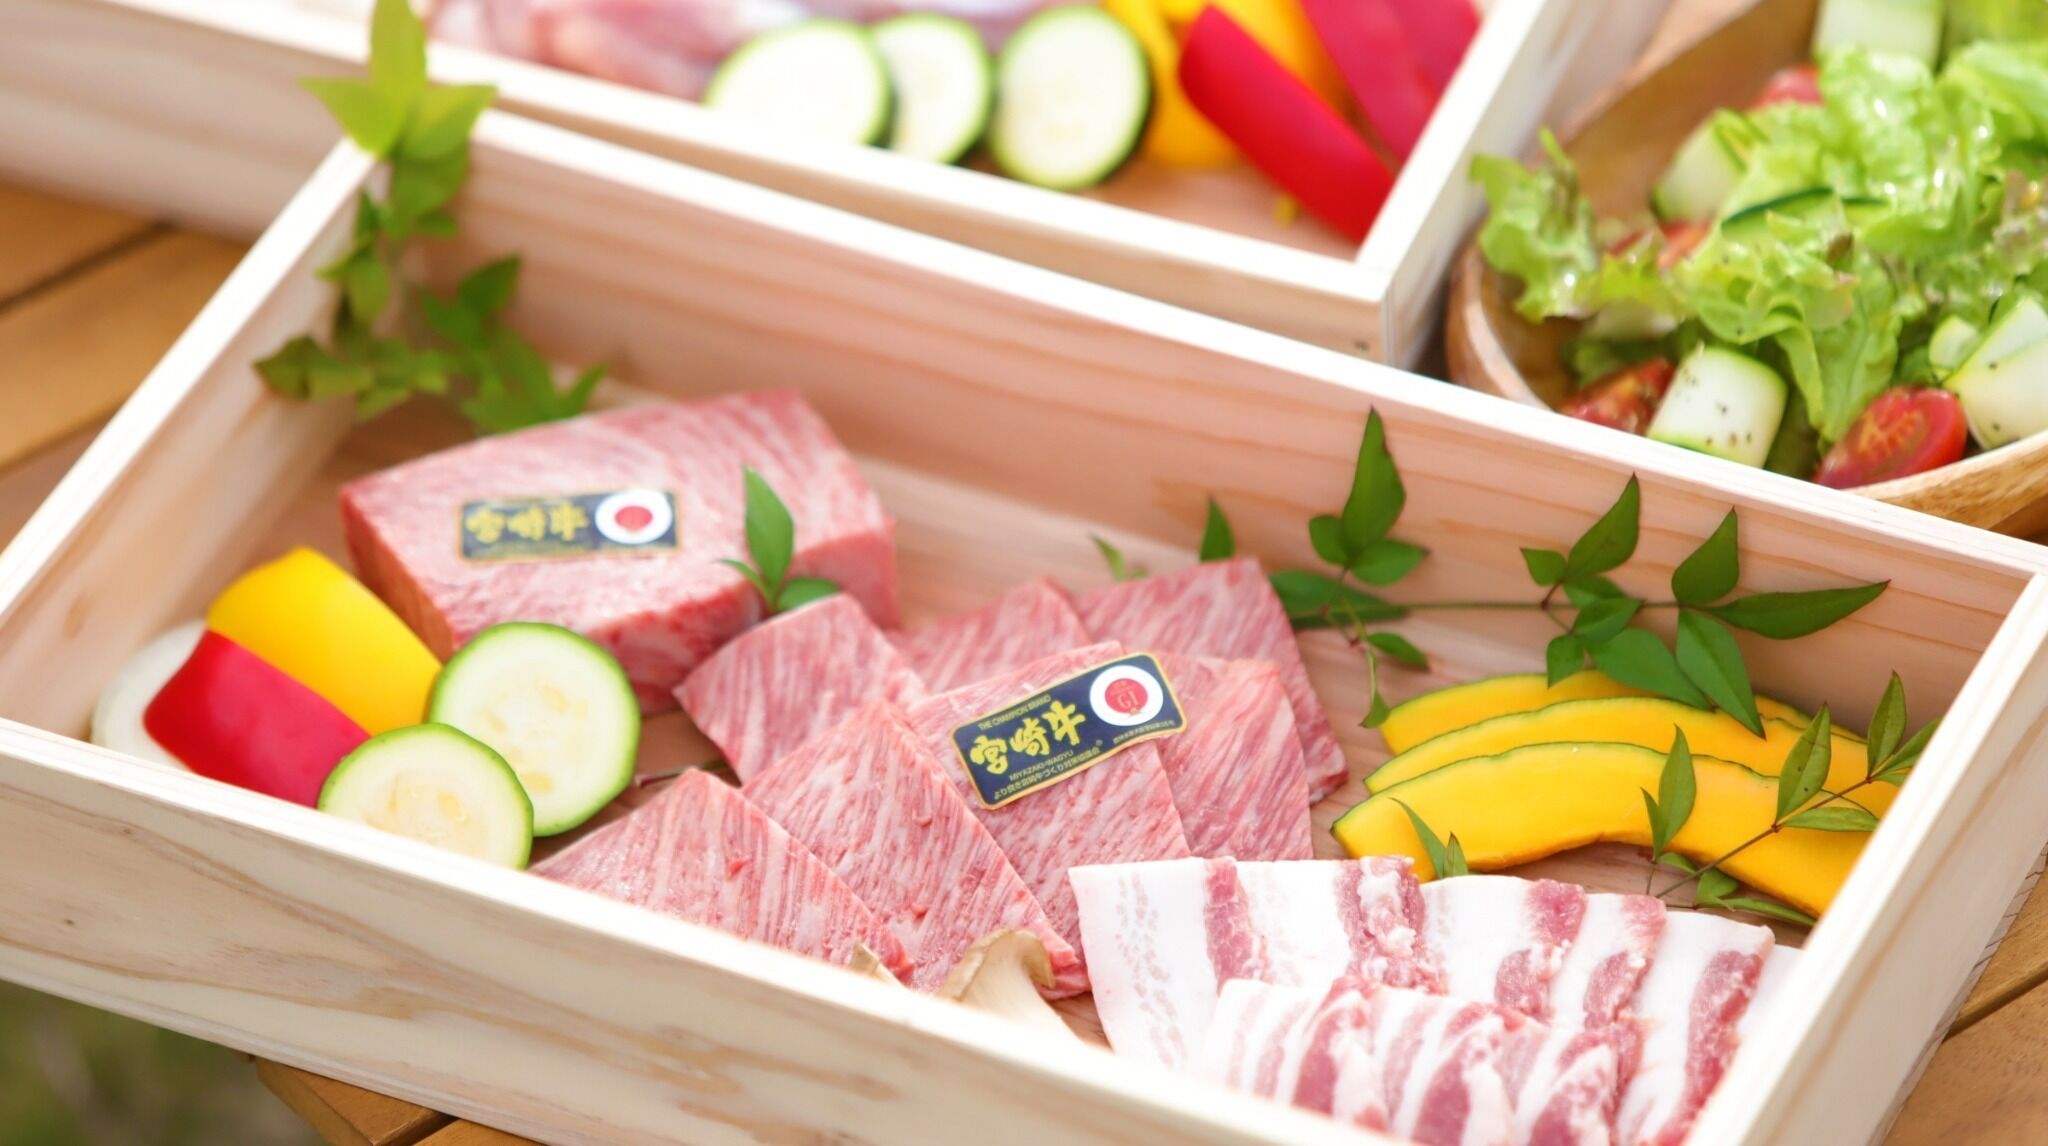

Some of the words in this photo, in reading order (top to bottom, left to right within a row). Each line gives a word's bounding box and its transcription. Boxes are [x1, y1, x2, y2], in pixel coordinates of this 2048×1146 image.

[970, 700, 1086, 775] 宮崎牛
[978, 720, 992, 731] THE
[993, 705, 1028, 725] CHAMPION
[1029, 694, 1052, 712] BRAND
